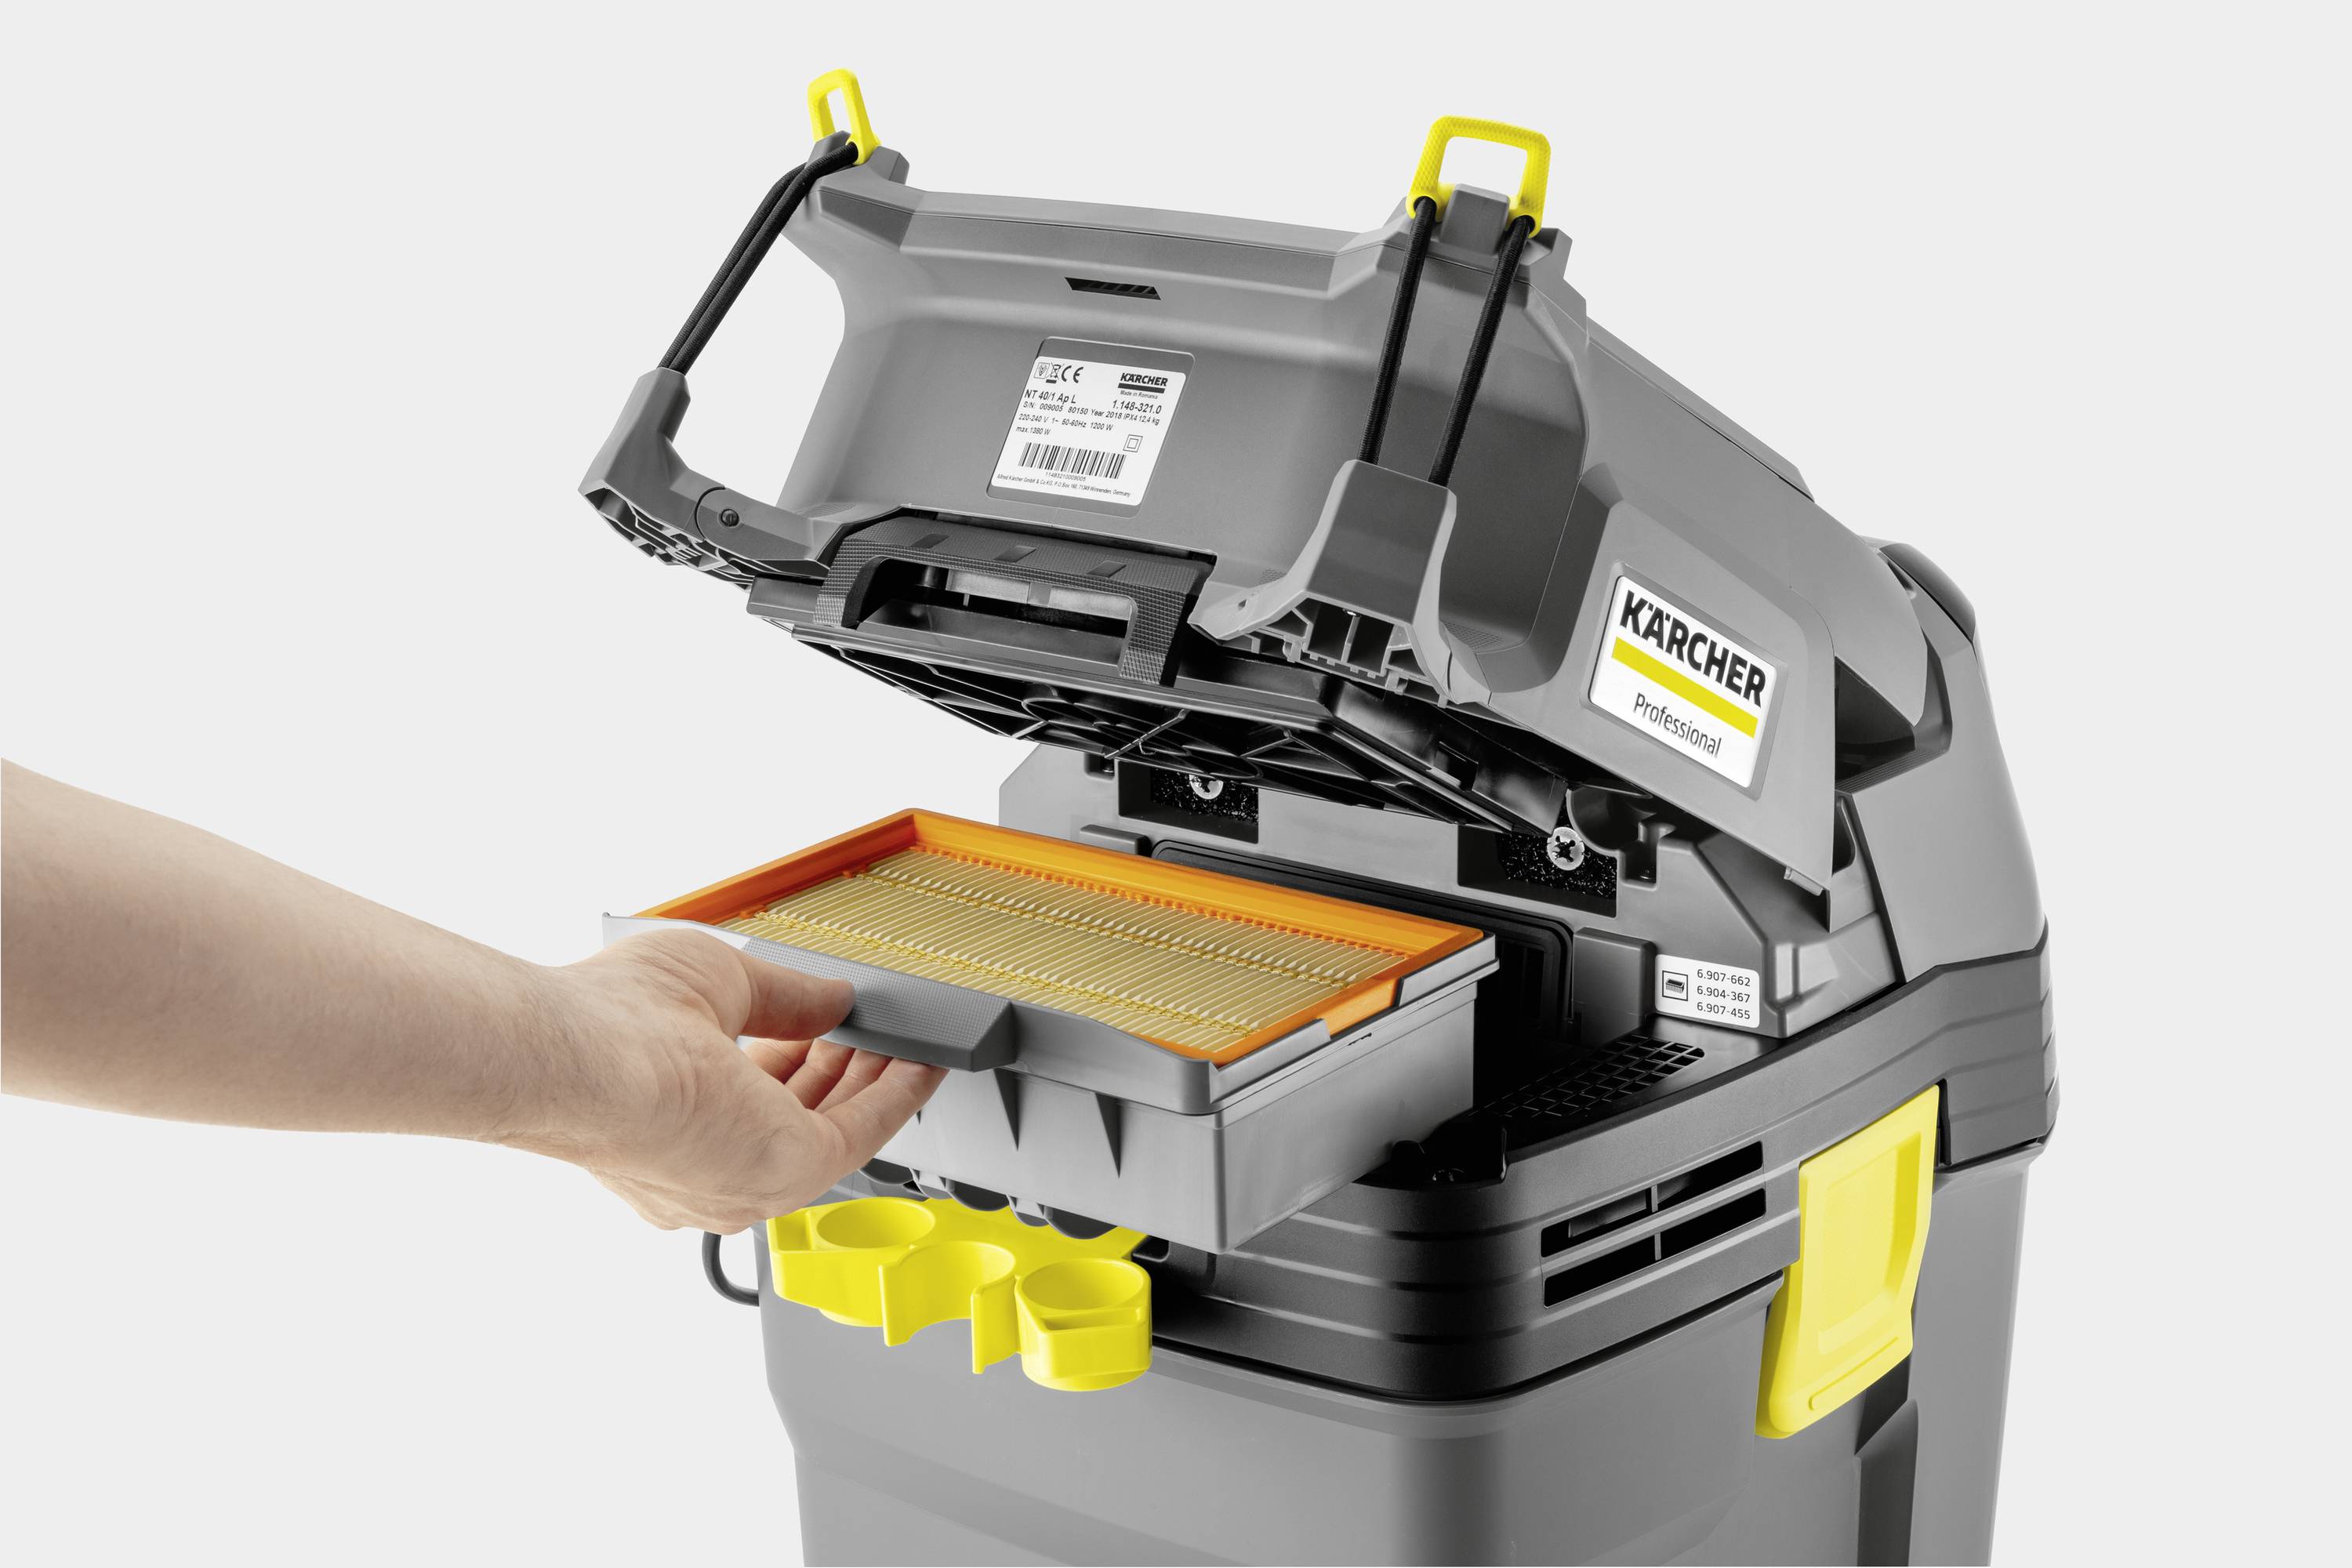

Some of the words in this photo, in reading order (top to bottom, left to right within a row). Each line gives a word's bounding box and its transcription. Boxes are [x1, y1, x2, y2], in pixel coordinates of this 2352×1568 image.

[1120, 372, 1168, 387] KÄRCHER
[1024, 389, 1038, 399] NT
[1039, 390, 1056, 401] 40/1
[1057, 393, 1069, 405] Ap
[1071, 394, 1076, 404] L
[1040, 403, 1064, 412] 009005
[1068, 406, 1088, 415] 80150
[1105, 411, 1122, 419] 2018
[1152, 417, 1160, 426] kg
[1112, 399, 1162, 414] 1.148-321.0
[1018, 413, 1042, 423] 220-240
[1062, 419, 1087, 428] 50-60Hz
[1091, 422, 1105, 430] 1200
[1620, 590, 1766, 707] KÄRCHER
[1633, 692, 1721, 758] Professional
[1697, 969, 1751, 986] 6.907-662
[1697, 985, 1751, 1003] 6.904-367
[1697, 1002, 1751, 1019] 6.907-455
